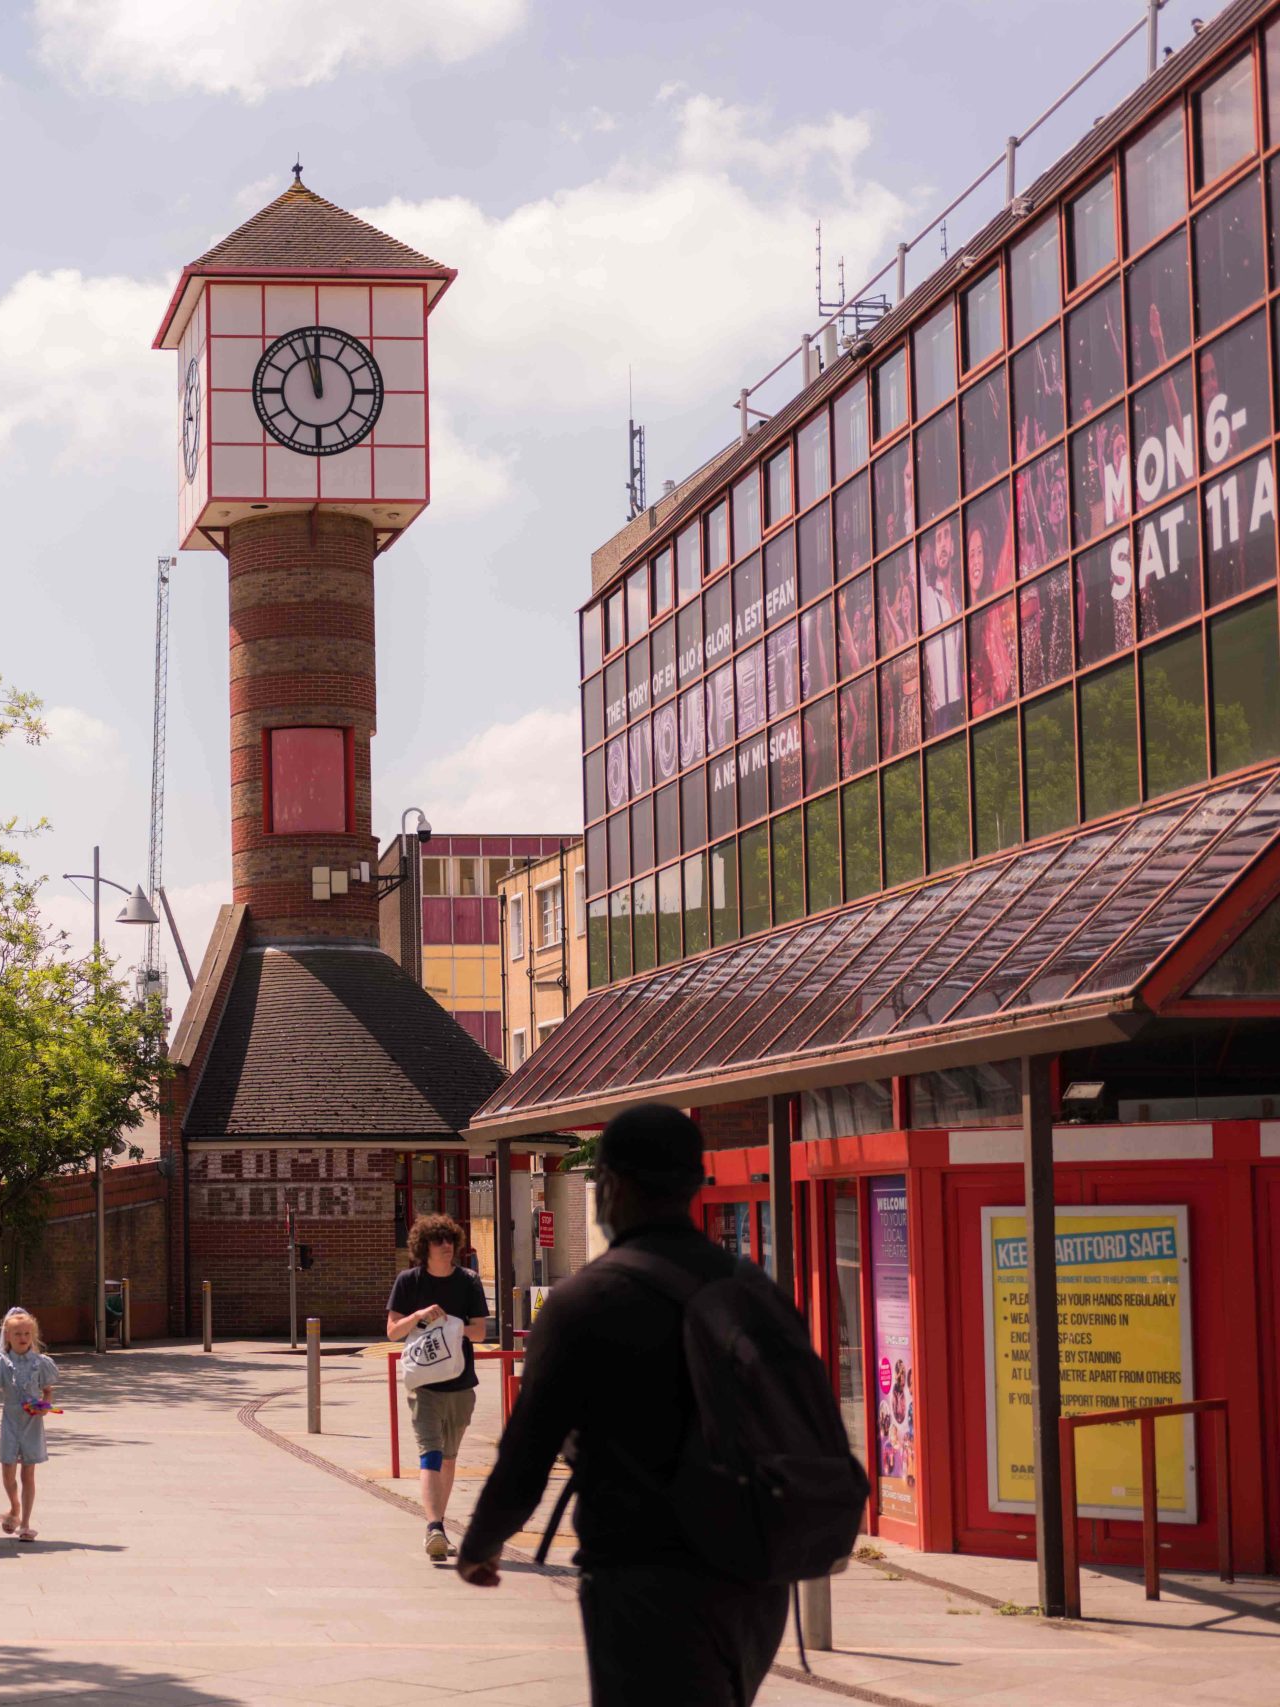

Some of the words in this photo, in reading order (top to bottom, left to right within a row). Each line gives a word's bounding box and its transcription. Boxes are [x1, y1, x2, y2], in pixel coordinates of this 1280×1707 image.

[1104, 413, 1194, 525] MON
[1206, 393, 1247, 464] 6-
[1110, 505, 1185, 601] SAT
[606, 700, 620, 727] THE
[622, 680, 649, 716] STORY
[652, 670, 664, 696] OF
[666, 649, 696, 687] EMILIO
[705, 614, 743, 658] GLORA
[745, 576, 795, 632] ESTEFAN
[607, 727, 641, 806] ON
[643, 682, 715, 786] YOUR
[714, 768, 722, 792] A
[723, 751, 750, 787] NEW
[752, 726, 800, 771] MUSICAL
[208, 1149, 382, 1178] COMIC
[541, 1216, 552, 1224] STOP
[880, 1213, 889, 1226] TO
[890, 1212, 907, 1226] YOUR
[884, 1228, 904, 1242] LOCAL
[881, 1244, 908, 1258] THEATRE
[997, 1242, 1028, 1268] KEE
[1055, 1234, 1127, 1263] ARTFORD
[1129, 1230, 1173, 1257] SAFE
[1009, 1293, 1029, 1305] PLEA
[1068, 1293, 1091, 1306] YOUR
[1093, 1294, 1123, 1307] HANDS
[1124, 1294, 1176, 1307] REGULARLY
[1010, 1312, 1030, 1324] WEA
[1070, 1314, 1116, 1326] COVERING
[1119, 1314, 1129, 1326] IN
[1058, 1332, 1092, 1345] SPACES
[1012, 1350, 1031, 1361] MAK
[1065, 1351, 1077, 1363] BY
[1078, 1351, 1122, 1364] STANDING
[1011, 1368, 1022, 1380] AT
[1089, 1370, 1118, 1383] APART
[1120, 1371, 1144, 1383] FROM
[1146, 1372, 1181, 1384] OTHERS
[1008, 1393, 1016, 1405] IF
[1096, 1395, 1119, 1408] FROM
[1121, 1396, 1137, 1408] THE
